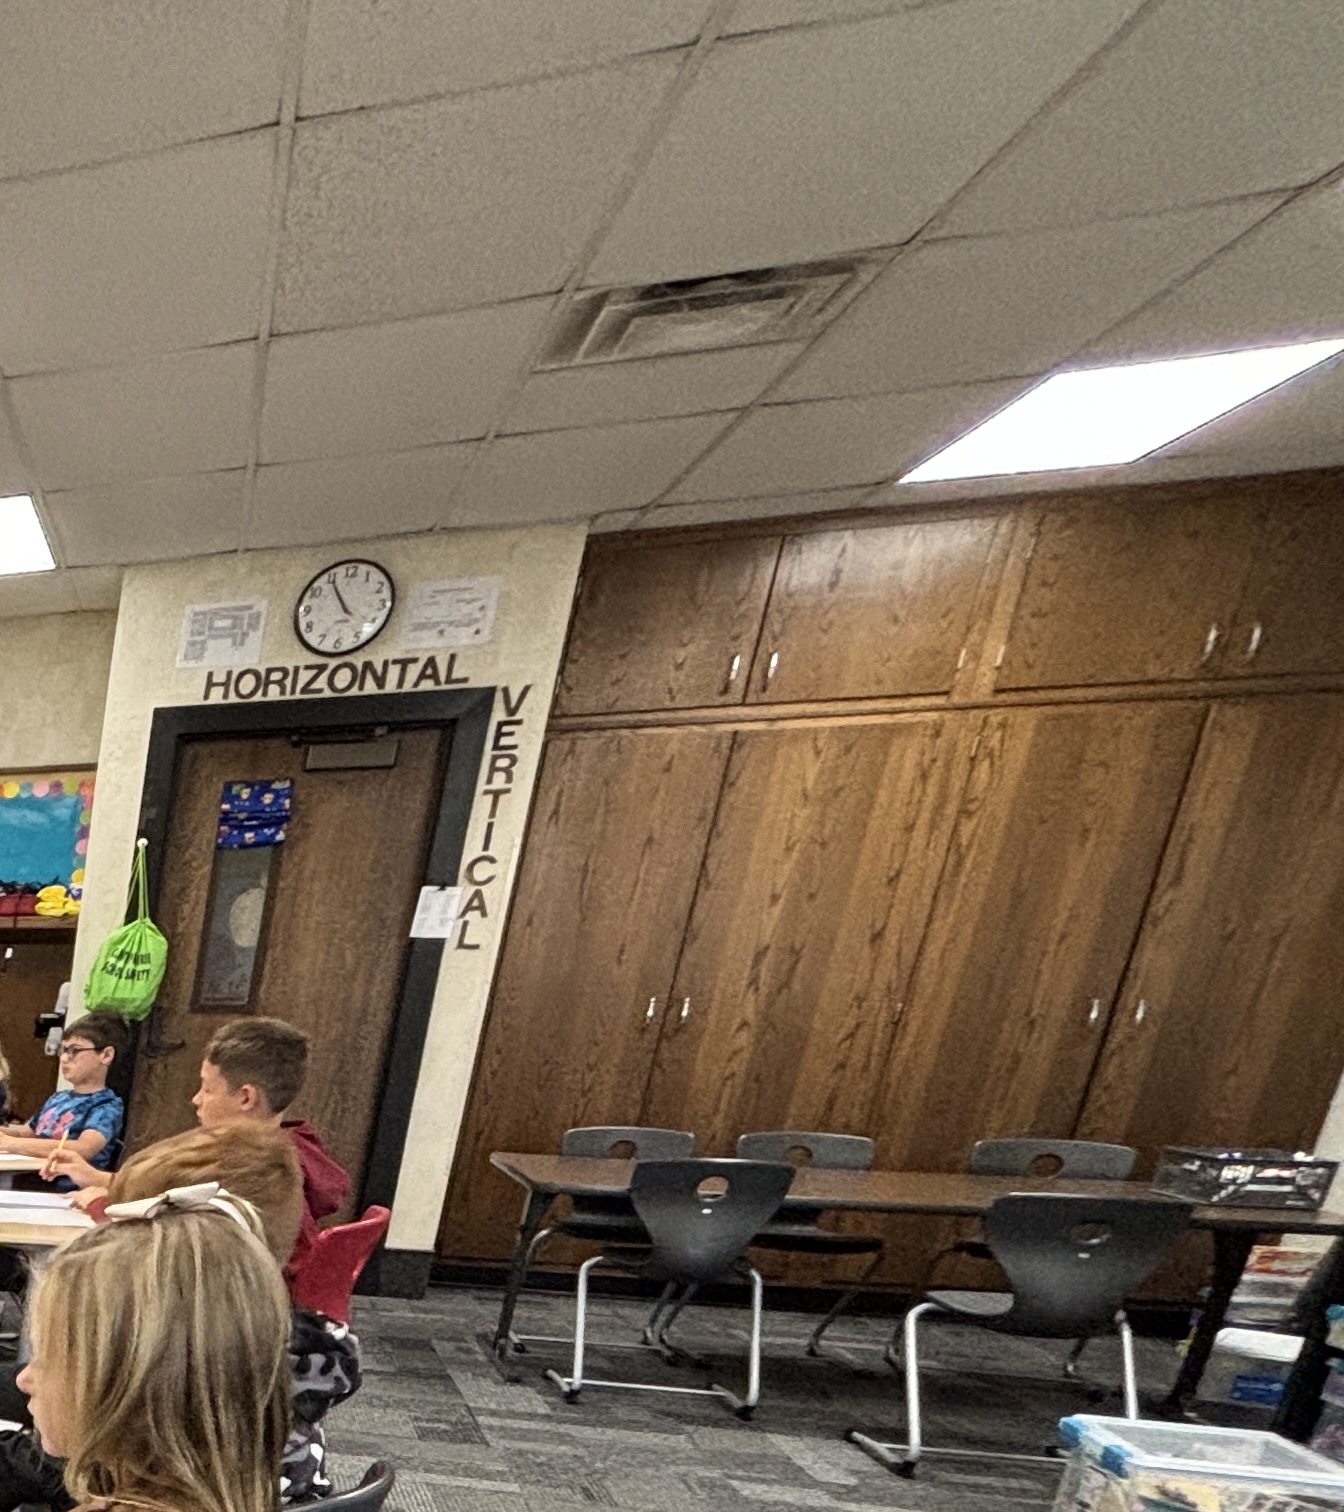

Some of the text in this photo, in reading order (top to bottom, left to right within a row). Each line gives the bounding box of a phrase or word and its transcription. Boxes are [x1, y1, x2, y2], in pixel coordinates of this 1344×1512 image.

[345, 565, 359, 578] 12
[365, 570, 371, 583] 1
[375, 581, 385, 594] 2
[303, 604, 312, 617] 9
[376, 598, 387, 611] 3
[304, 620, 314, 634] 8
[318, 633, 328, 646] 7
[333, 637, 343, 649] 6
[203, 653, 471, 701] HORIZONTAL
[455, 684, 533, 951] VERTICAL
